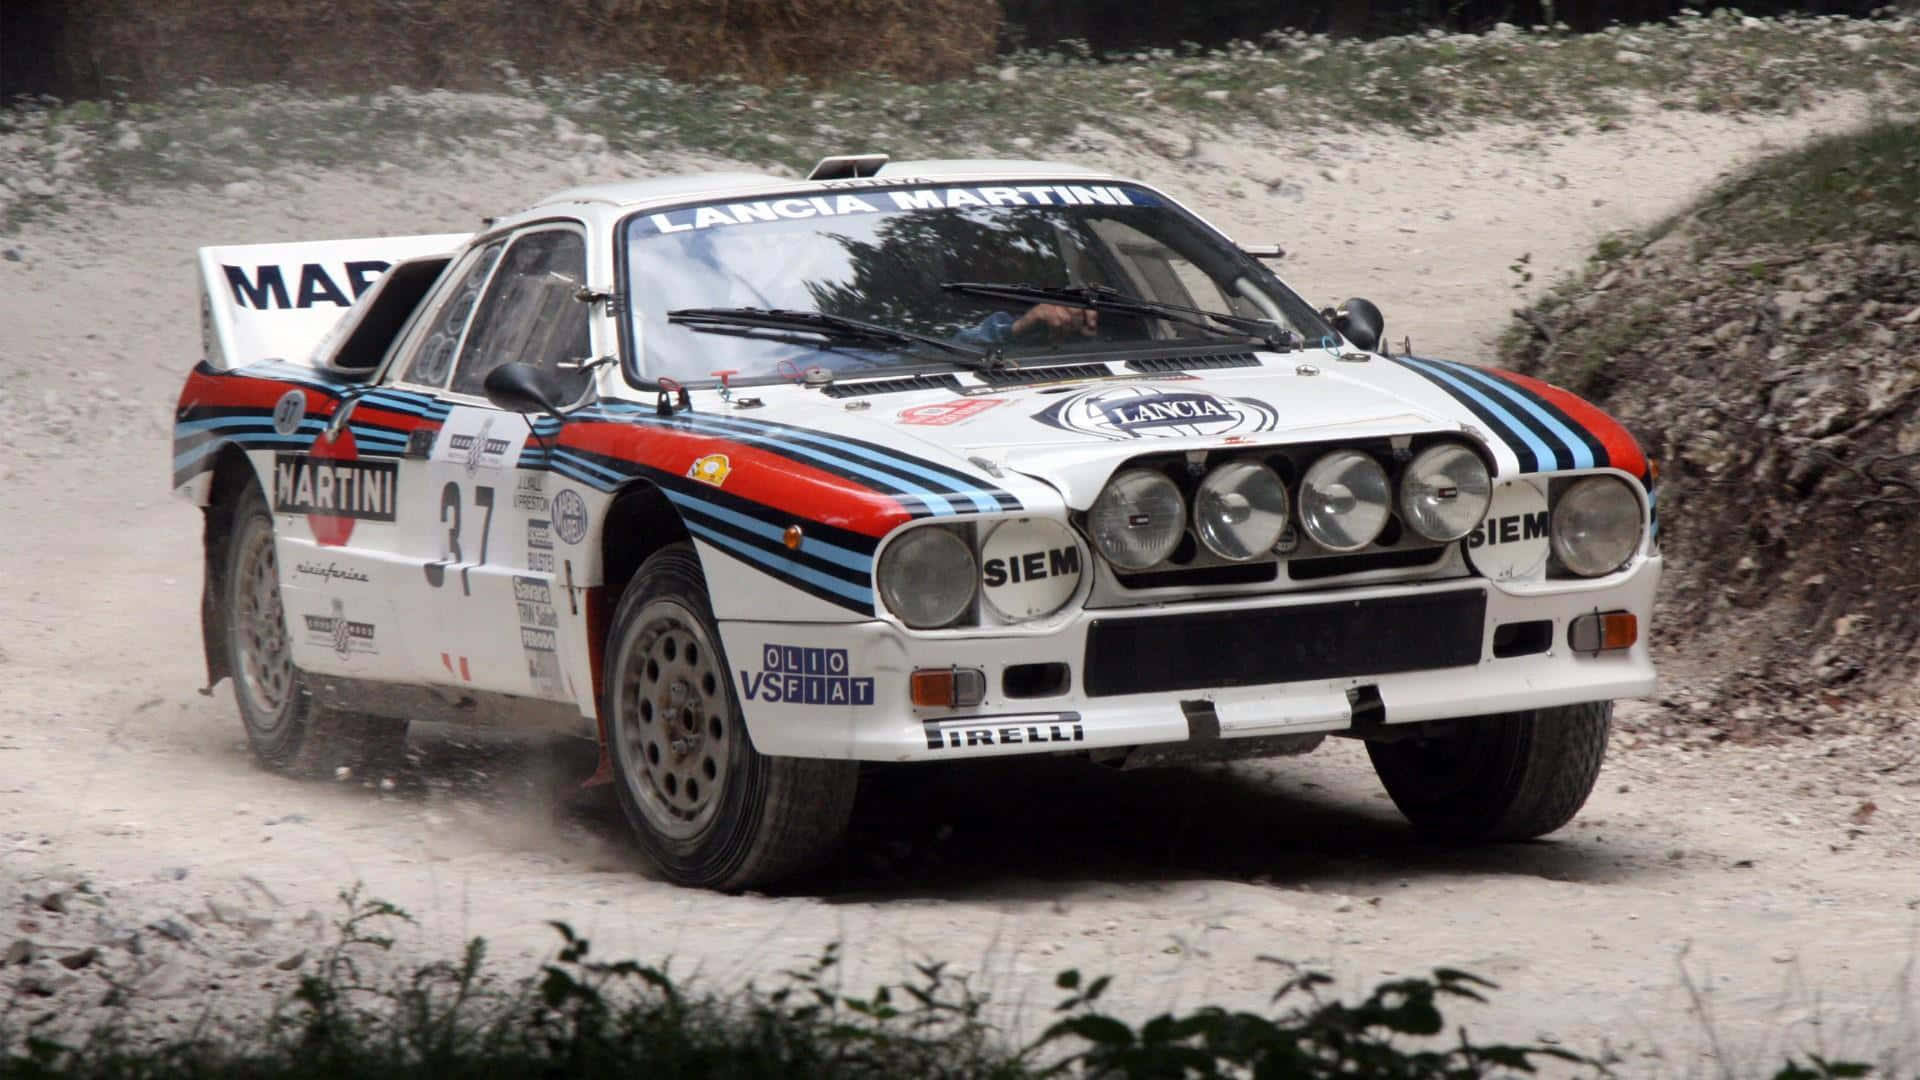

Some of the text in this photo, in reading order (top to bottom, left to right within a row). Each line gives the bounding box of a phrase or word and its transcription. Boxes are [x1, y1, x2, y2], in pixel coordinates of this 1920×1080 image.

[649, 186, 1135, 234] LANCIA MARTINI
[1112, 399, 1226, 424] LANCIA
[277, 462, 393, 514] MARTINI
[423, 481, 495, 597] 37
[1468, 511, 1552, 549] SIEM
[983, 545, 1079, 588] SIEM
[766, 647, 845, 673] OLIO
[922, 711, 1084, 750] PIRELLI
